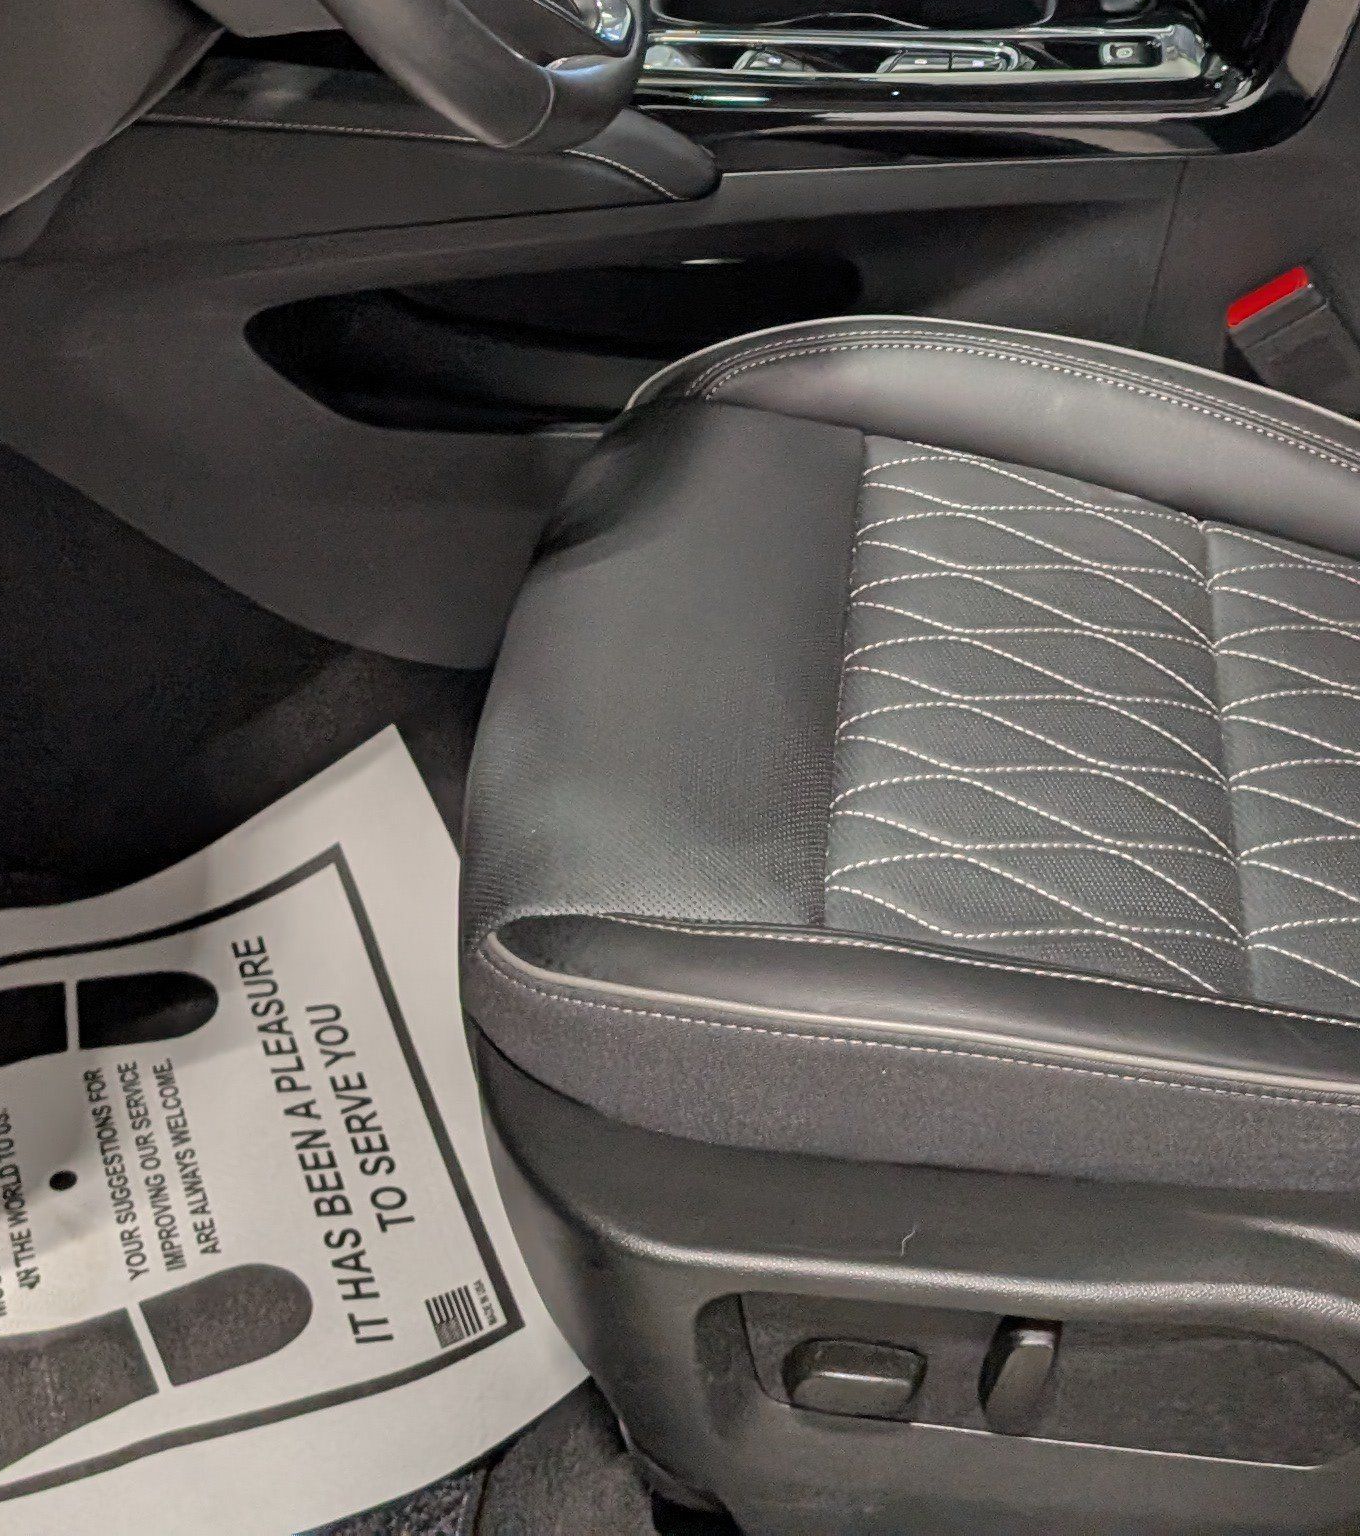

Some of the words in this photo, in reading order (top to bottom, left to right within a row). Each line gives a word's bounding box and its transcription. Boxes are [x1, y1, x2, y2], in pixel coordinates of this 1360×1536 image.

[231, 935, 311, 1092] PLEASURE
[305, 1002, 356, 1067] YOU
[83, 1066, 109, 1102] FOR
[117, 1060, 151, 1130] SERVICE
[152, 1057, 192, 1146] WELCOME.
[283, 1100, 321, 1119] A
[135, 1131, 161, 1170] OUR
[329, 1070, 396, 1174] SERVE
[91, 1104, 137, 1224] SUGGESTIONS
[175, 1148, 211, 1214] ALWAYS
[289, 1128, 353, 1217] BEEN
[144, 1173, 187, 1271] IMPROVING
[192, 1217, 222, 1254] ARE
[370, 1185, 415, 1231] TO
[10, 1228, 36, 1266] THE
[17, 1266, 41, 1289] IN
[120, 1226, 150, 1280] YOUR
[323, 1227, 380, 1300] HAS
[347, 1312, 394, 1344] IT
